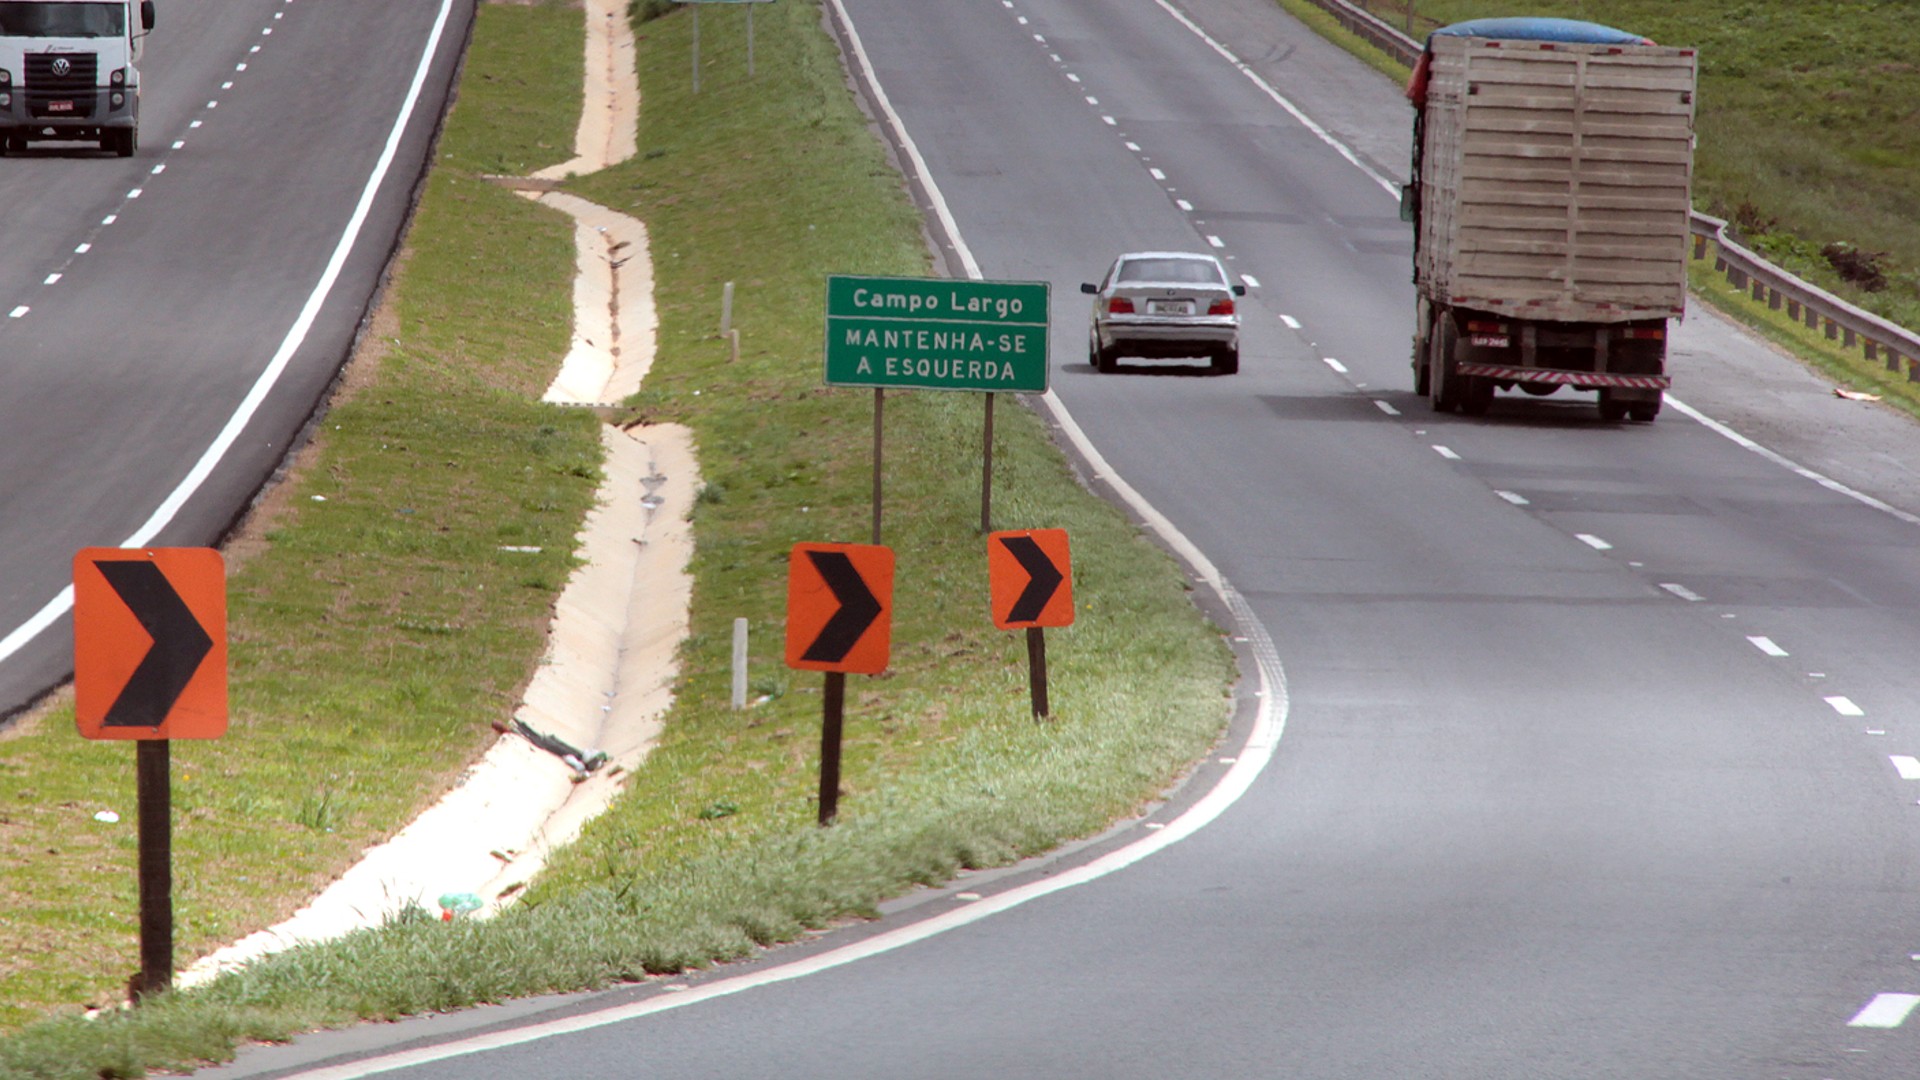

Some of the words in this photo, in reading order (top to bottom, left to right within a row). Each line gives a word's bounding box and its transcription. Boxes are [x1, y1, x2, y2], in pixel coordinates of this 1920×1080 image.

[854, 288, 938, 312] Campo
[951, 292, 1023, 318] Largo
[845, 328, 1026, 353] MANTENHA-SE
[856, 356, 872, 375] A
[886, 357, 1015, 380] ESQUERDA
